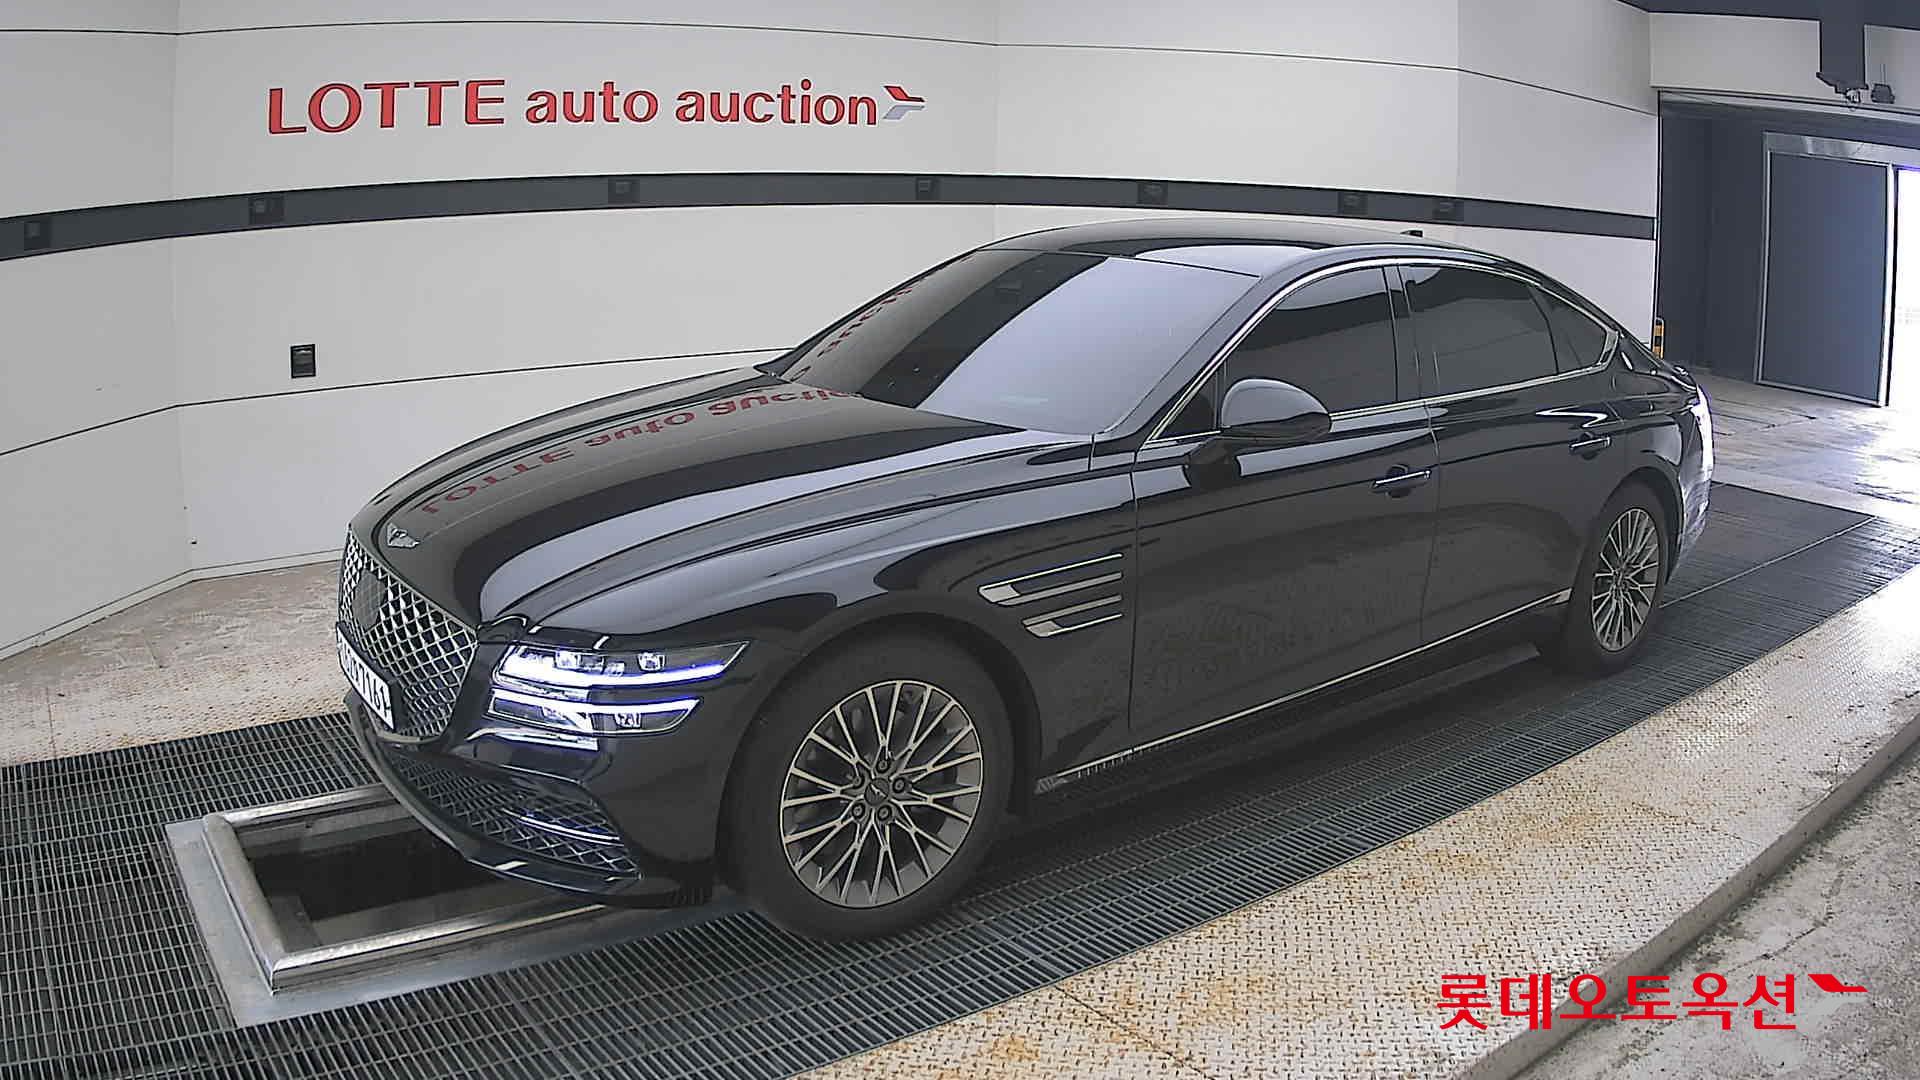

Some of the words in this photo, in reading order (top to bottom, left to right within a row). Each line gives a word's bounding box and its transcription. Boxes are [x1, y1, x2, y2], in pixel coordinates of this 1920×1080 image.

[270, 80, 505, 134] LOTTE
[524, 80, 659, 123] auto
[675, 79, 878, 125] auction
